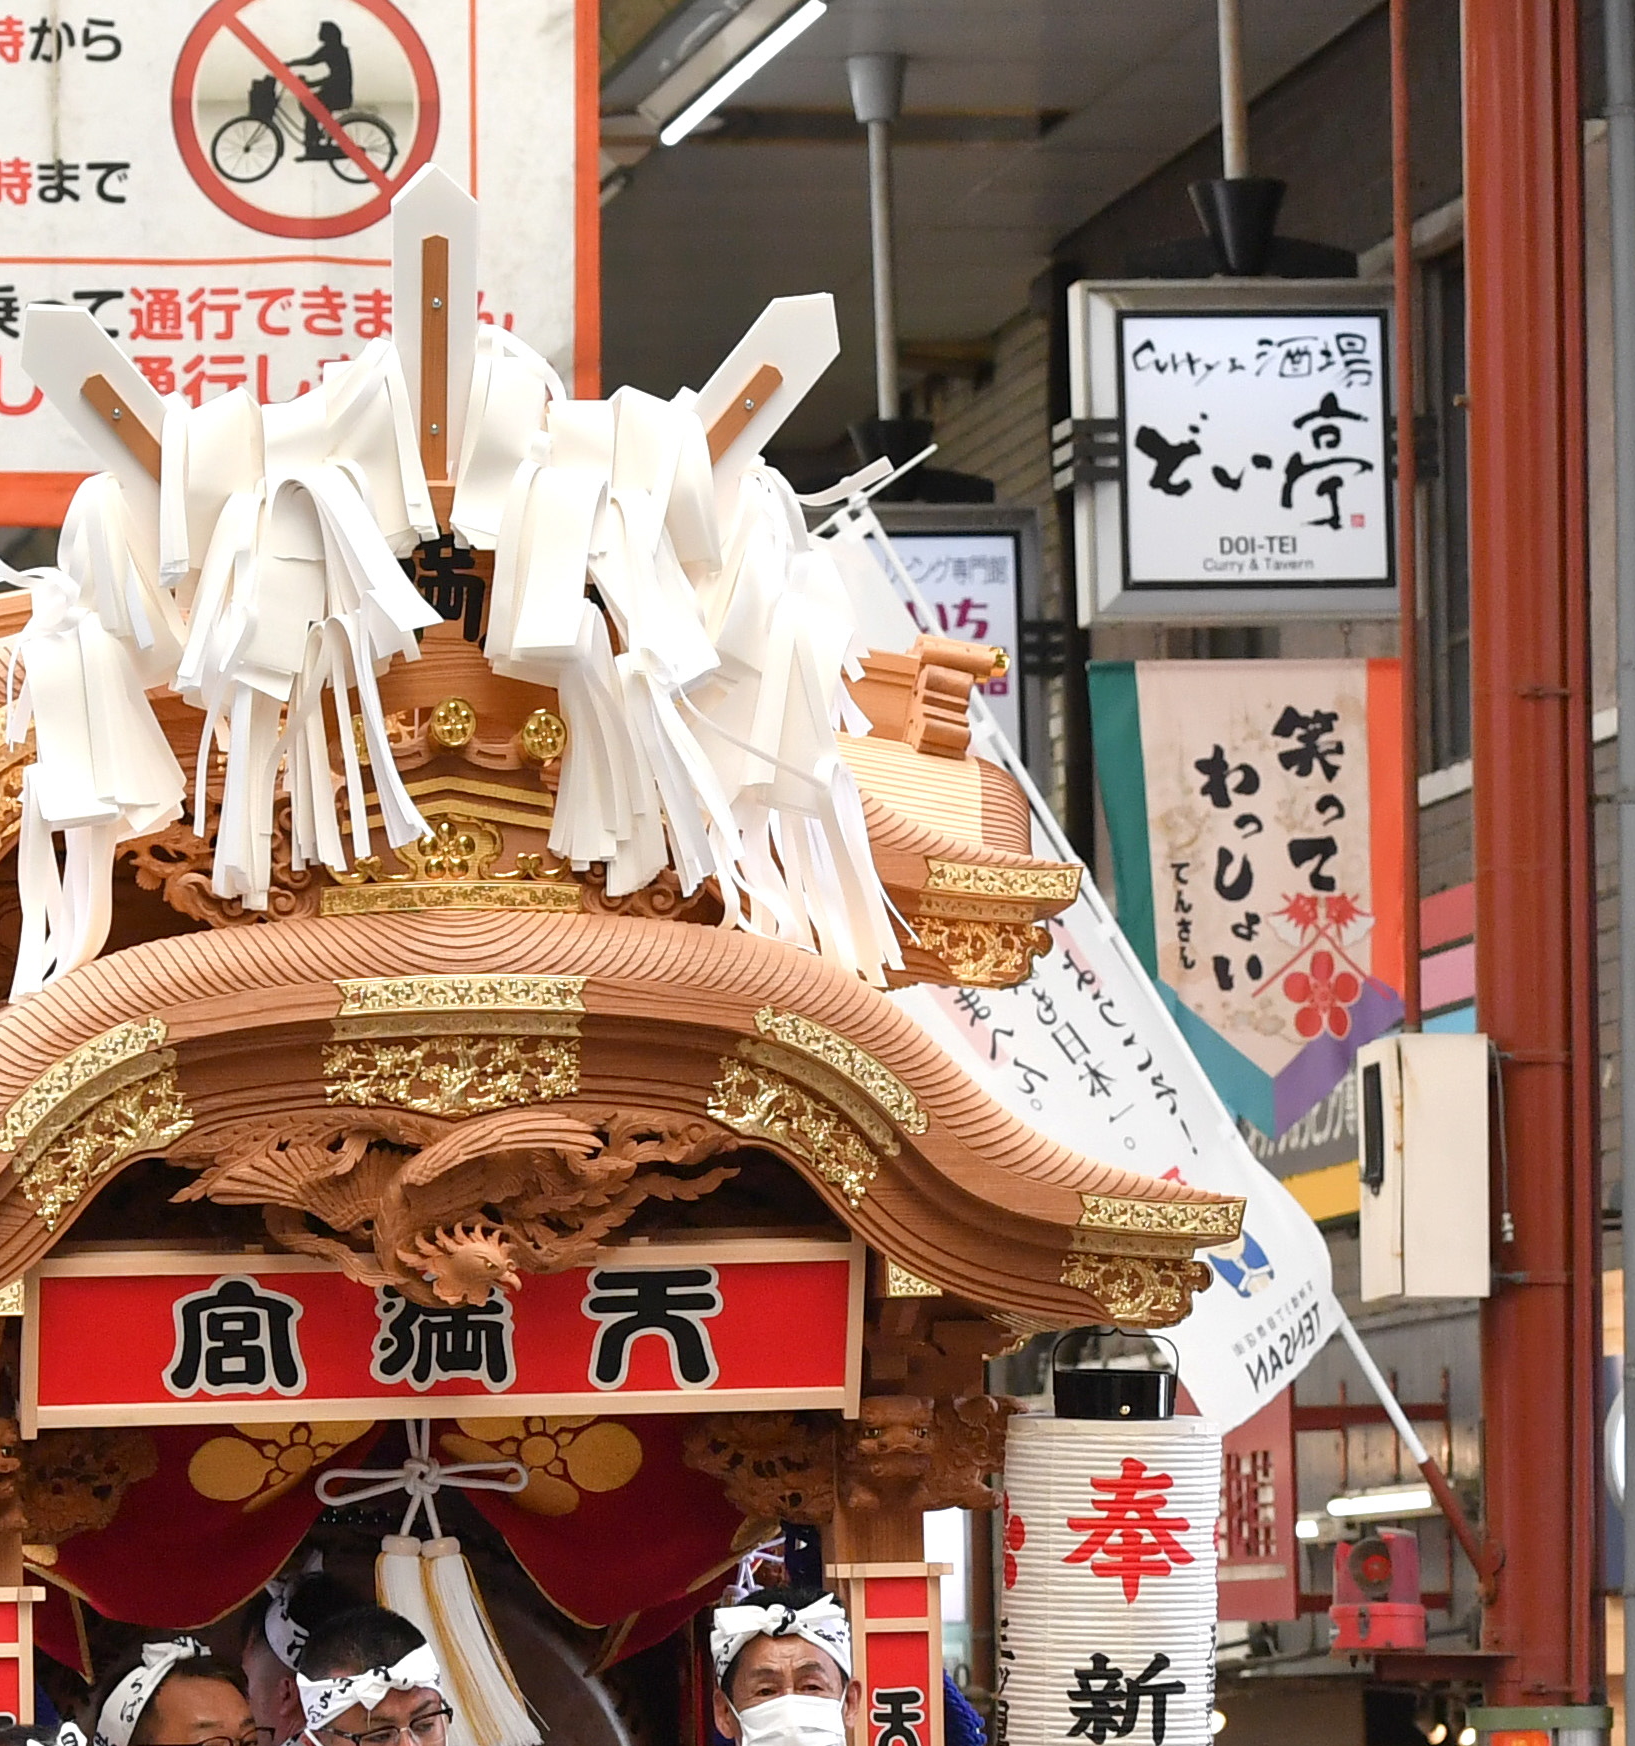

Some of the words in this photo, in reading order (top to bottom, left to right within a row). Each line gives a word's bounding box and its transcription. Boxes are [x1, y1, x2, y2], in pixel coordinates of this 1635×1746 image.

[1202, 557, 1245, 574] Curry
[1264, 557, 1315, 571] Tavern
[1219, 536, 1298, 556] DOI-TEI
[1270, 705, 1345, 893] 笑って
[1170, 862, 1197, 971] てんさん
[1195, 745, 1264, 992] わっしょい
[1062, 1456, 1196, 1605] 奉
